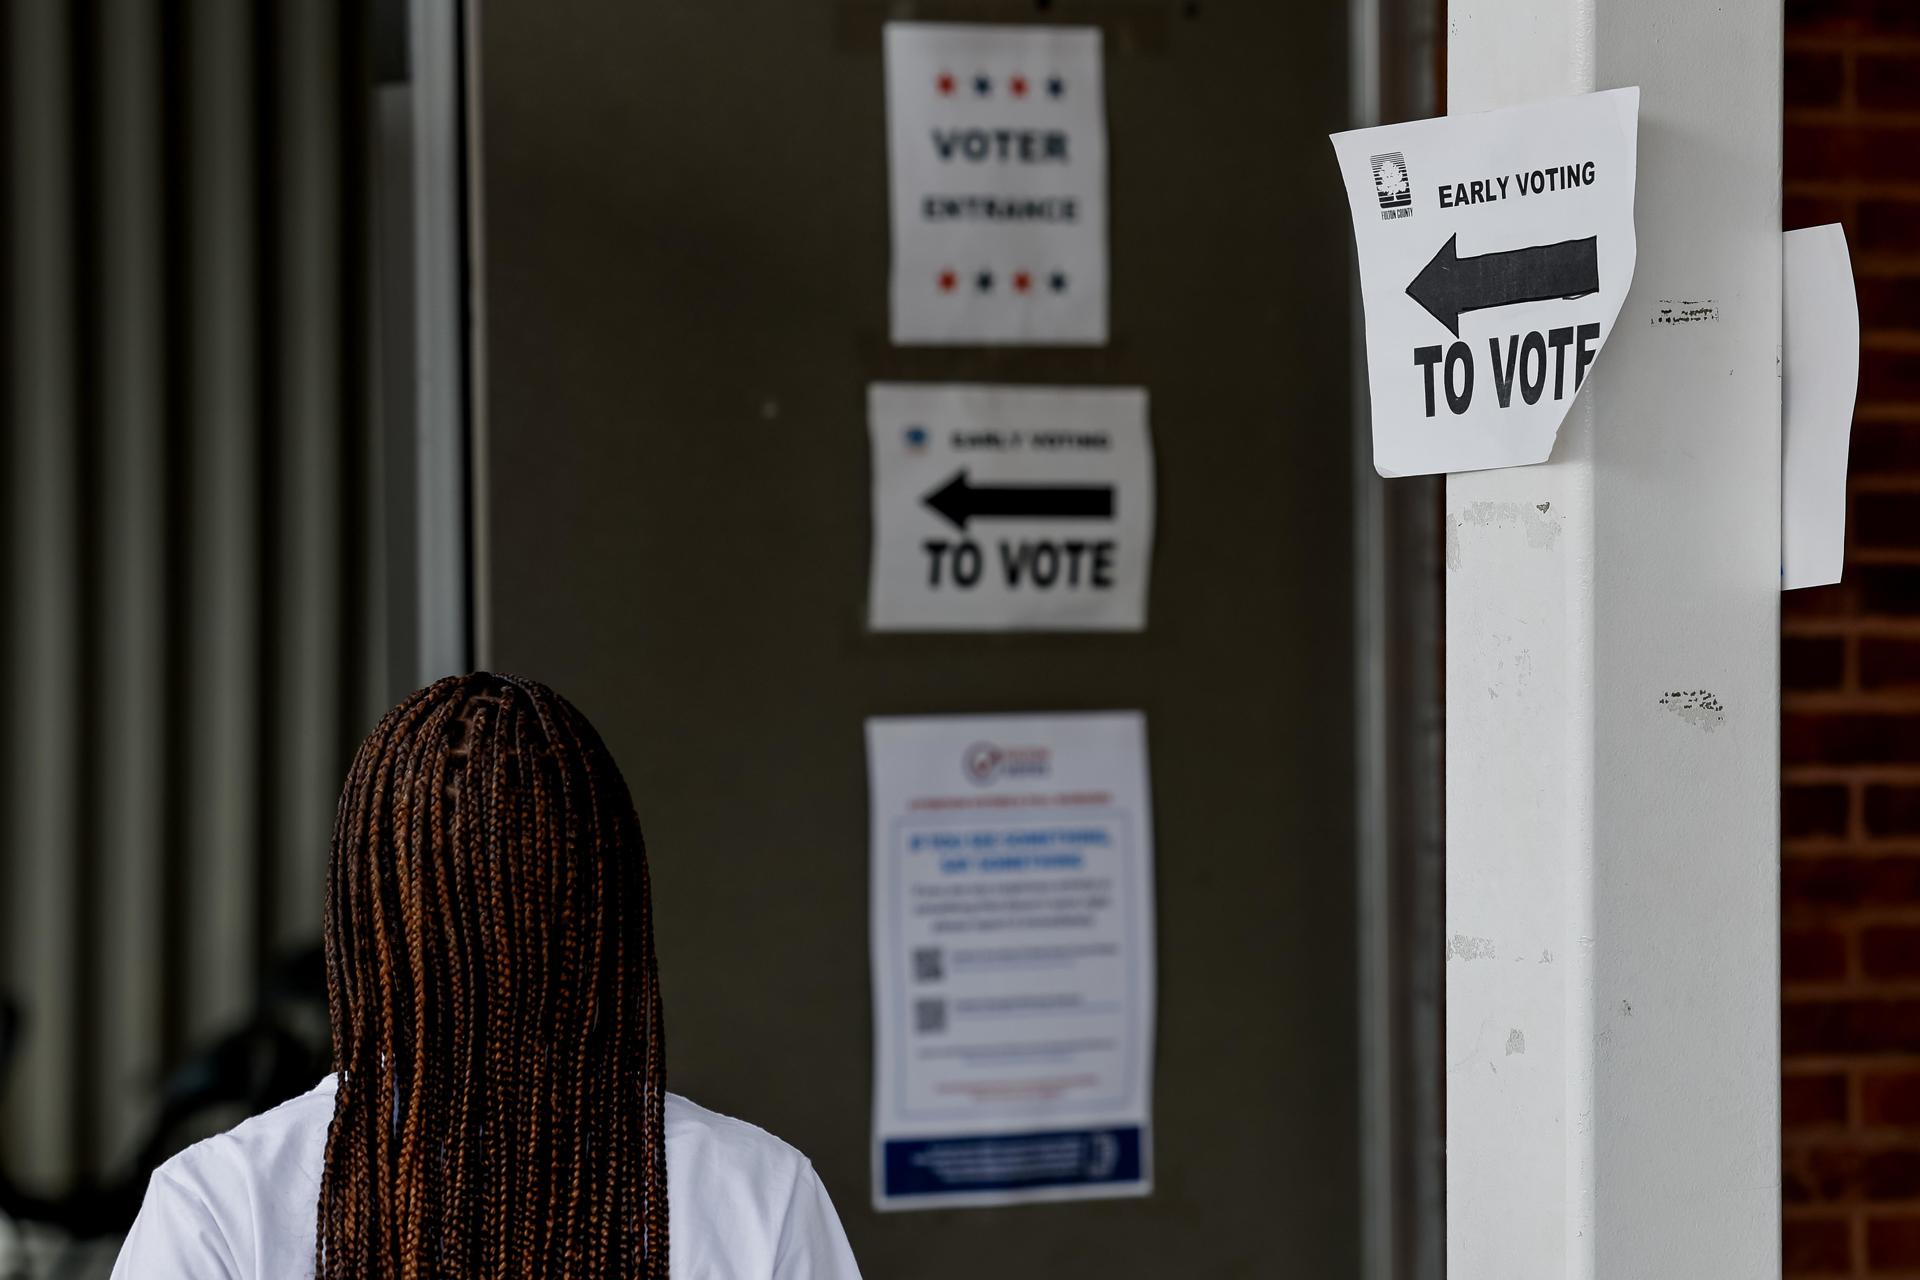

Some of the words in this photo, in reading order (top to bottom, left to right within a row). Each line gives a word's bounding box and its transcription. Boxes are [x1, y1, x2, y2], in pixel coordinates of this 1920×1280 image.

[931, 127, 1070, 164] VOTER
[1438, 175, 1509, 208] EARLY
[1515, 161, 1596, 196] VOTING
[923, 195, 1078, 222] ENTRANCE
[1381, 209, 1396, 220] FULTON
[1397, 207, 1413, 219] COUNTY
[1413, 340, 1474, 418] TO
[951, 429, 1025, 450] EARLY
[1032, 429, 1112, 450] VOTING
[924, 539, 983, 589] TO
[999, 539, 1116, 589] VOTE
